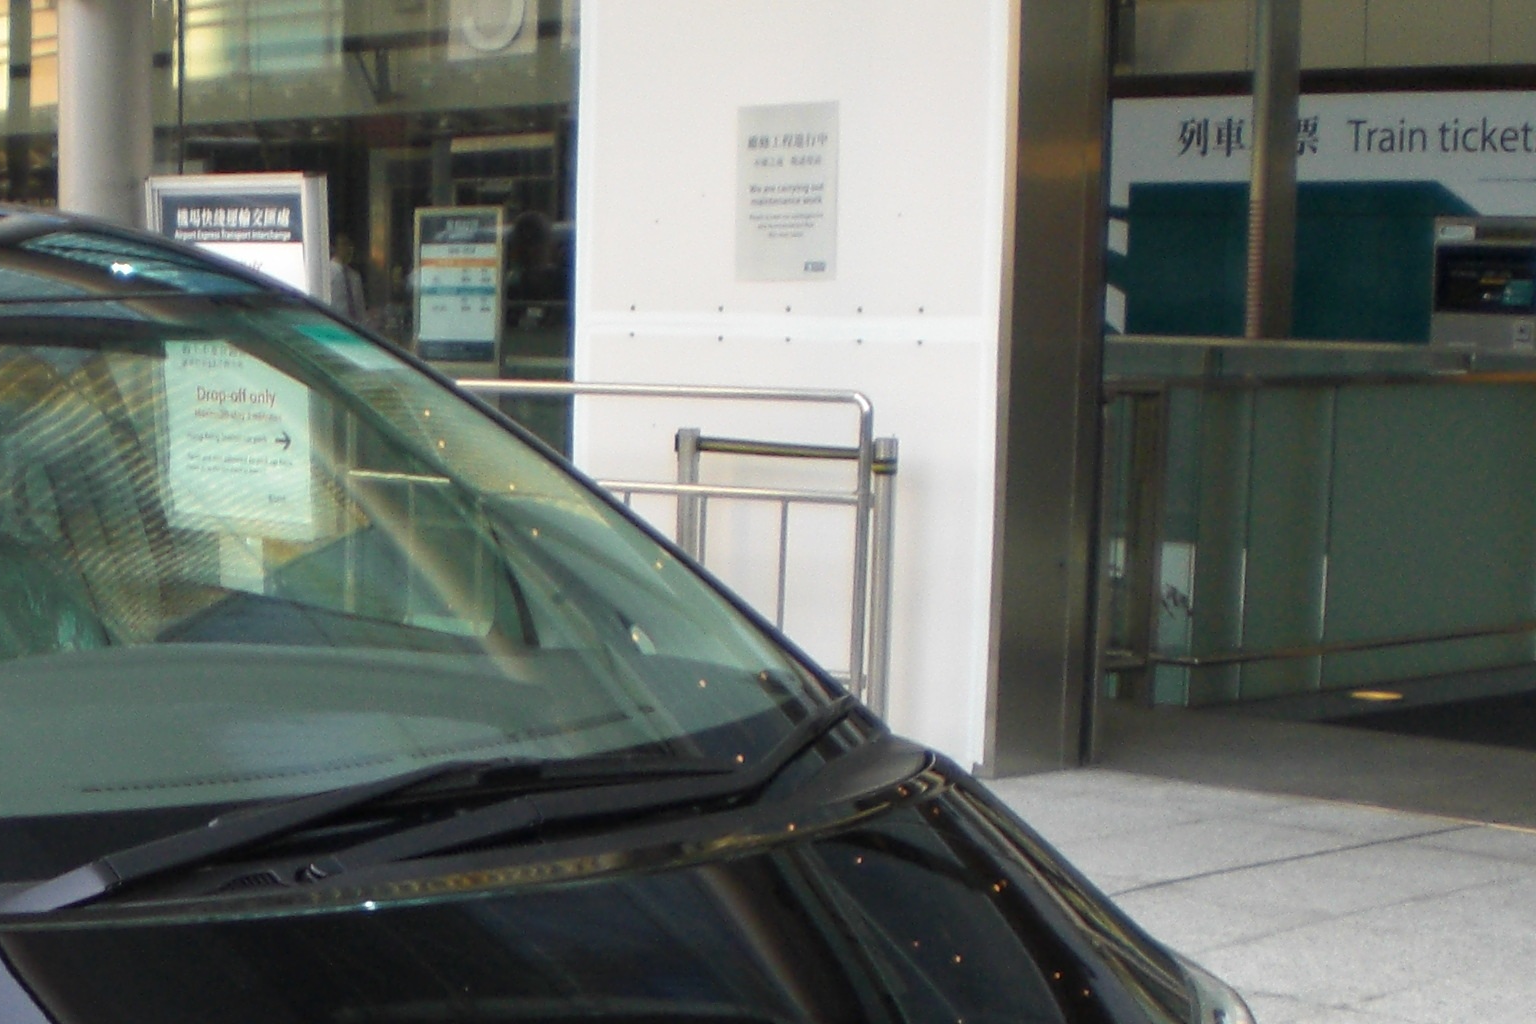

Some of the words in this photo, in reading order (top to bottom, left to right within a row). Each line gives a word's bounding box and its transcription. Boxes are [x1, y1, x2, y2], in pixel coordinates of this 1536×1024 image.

[1178, 116, 1319, 157] 列車票
[1347, 118, 1427, 153] Train
[1438, 117, 1536, 154] ticket
[175, 230, 196, 241] Airport
[198, 230, 220, 241] Express
[222, 229, 250, 242] Transport
[196, 385, 247, 405] Drop-off
[249, 388, 276, 407] only
